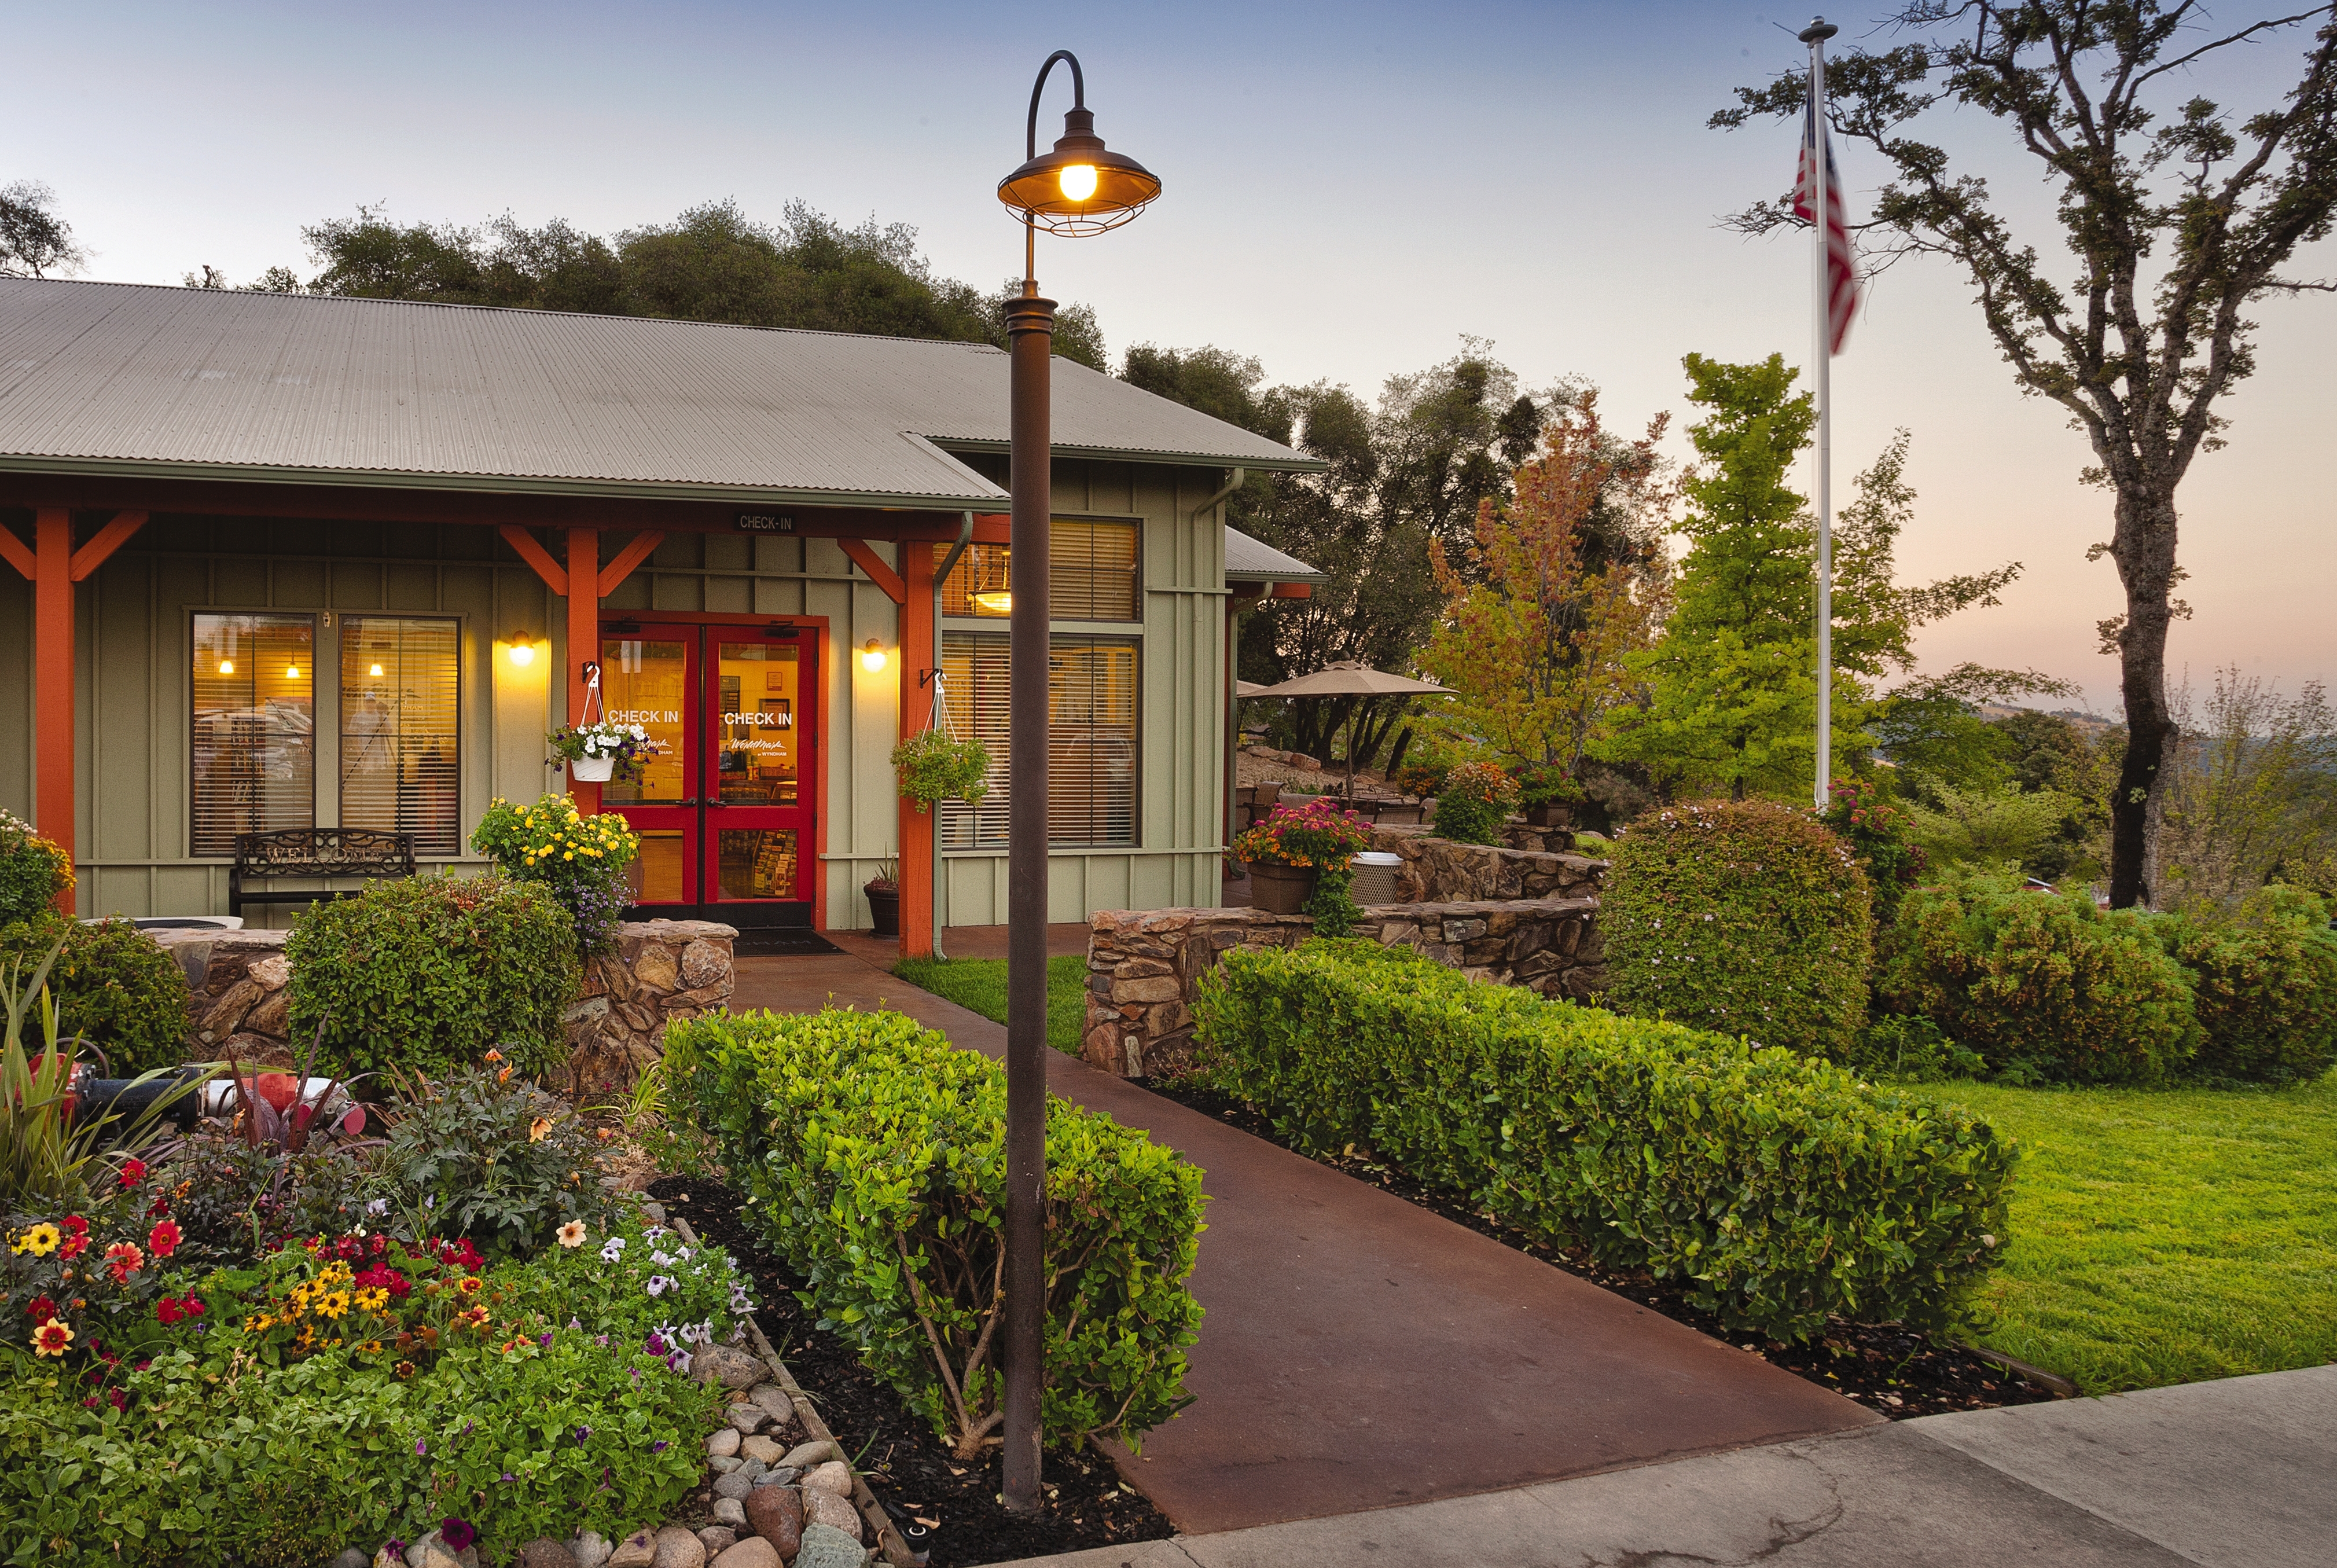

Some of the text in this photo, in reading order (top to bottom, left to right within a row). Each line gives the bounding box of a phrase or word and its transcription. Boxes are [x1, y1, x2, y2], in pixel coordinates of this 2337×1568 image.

[740, 516, 791, 530] CHECK-IN
[608, 710, 678, 723] CHECK IN
[725, 713, 792, 725] CHECK IN
[730, 738, 787, 750] WorldMark
[266, 847, 383, 864] WELCOME
